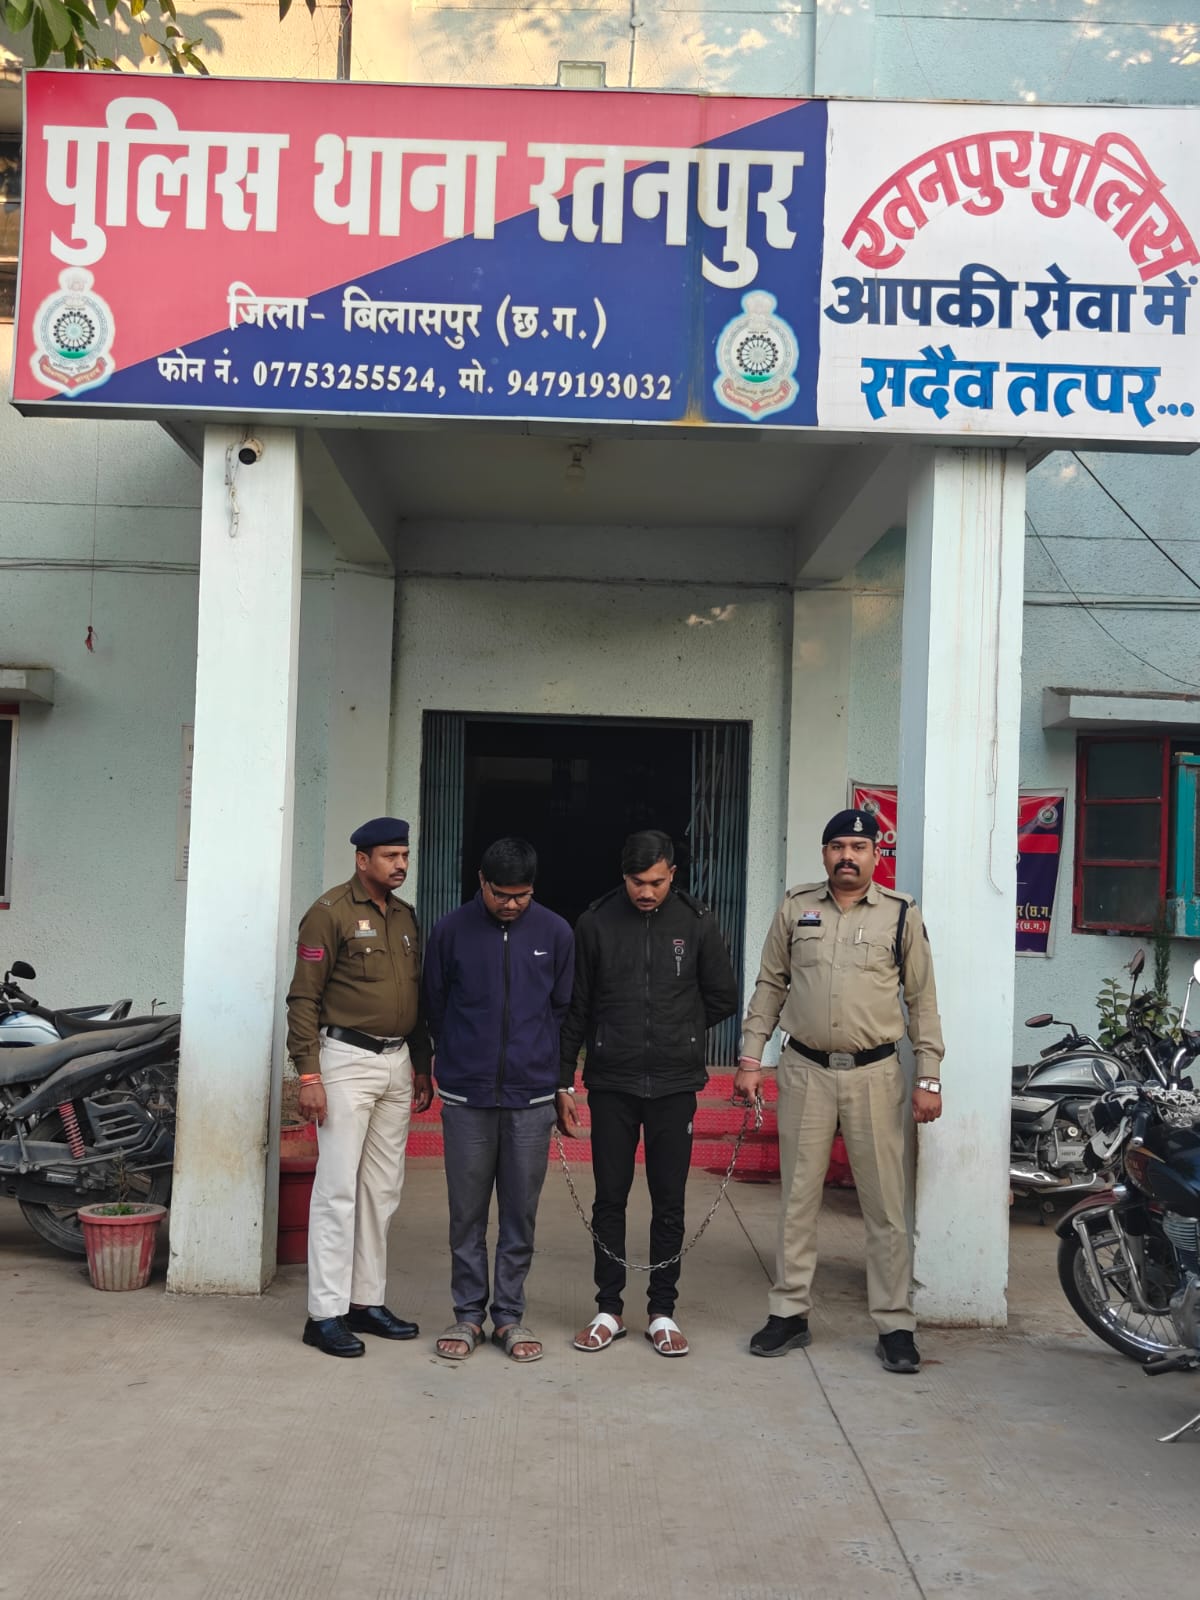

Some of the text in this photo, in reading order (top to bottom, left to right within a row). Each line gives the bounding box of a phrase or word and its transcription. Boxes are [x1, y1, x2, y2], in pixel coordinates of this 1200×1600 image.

[43, 97, 804, 288] पुलिस थाना रतनपुर
[841, 131, 1200, 282] रतनपुर पुलिस
[342, 285, 482, 349] बिलासपुर
[496, 294, 607, 349] (छ.ग.)
[824, 263, 1199, 338] आपकी सेवा में
[157, 347, 672, 400] फोन नं. 07753255524, मो. 9479193032
[860, 344, 1000, 420] सदैव
